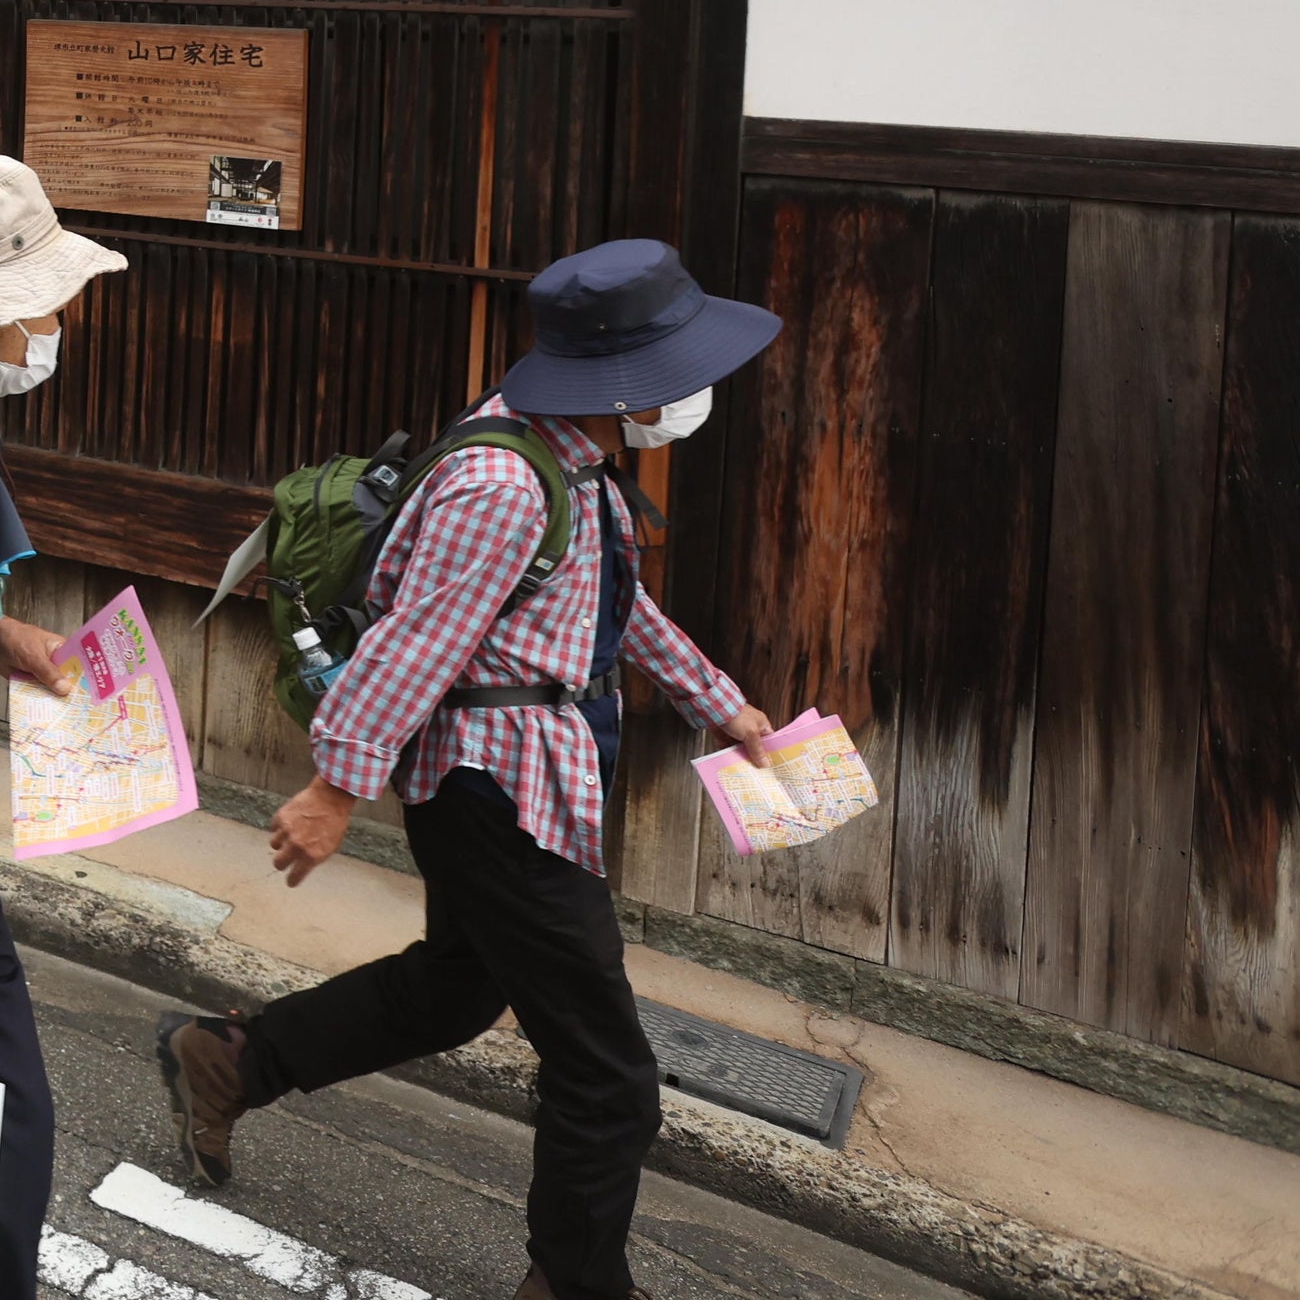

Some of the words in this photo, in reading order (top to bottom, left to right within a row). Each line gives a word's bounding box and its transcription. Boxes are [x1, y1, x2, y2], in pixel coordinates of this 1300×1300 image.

[127, 40, 265, 68] 山口家住宅
[118, 607, 147, 666] KANSAI
